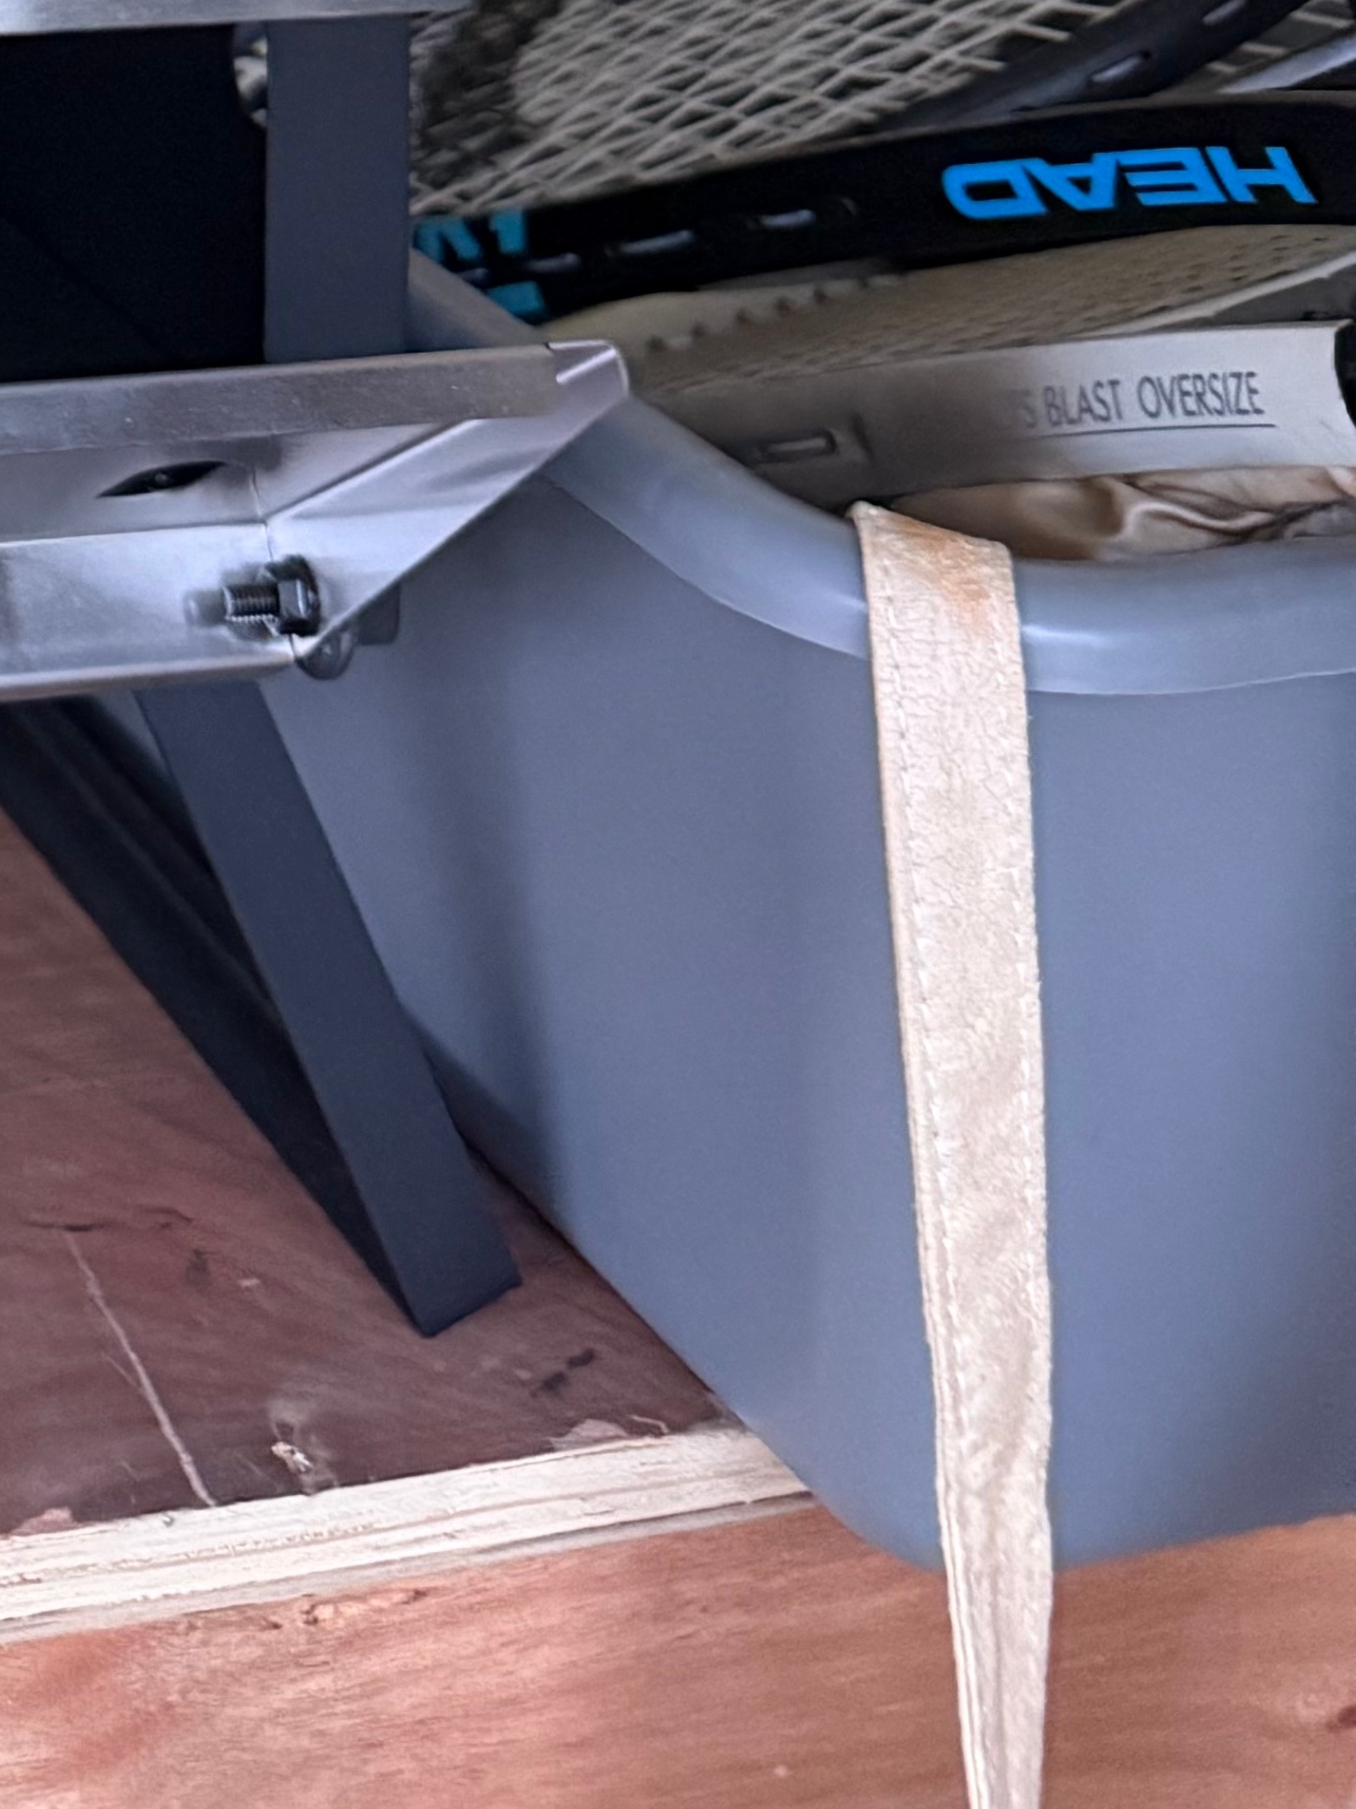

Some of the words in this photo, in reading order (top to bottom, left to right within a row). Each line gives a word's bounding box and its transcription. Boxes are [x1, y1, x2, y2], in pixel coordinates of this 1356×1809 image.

[941, 145, 1318, 222] HEAD
[1043, 378, 1122, 426] BLAST
[1137, 370, 1265, 419] OVERSIZE
